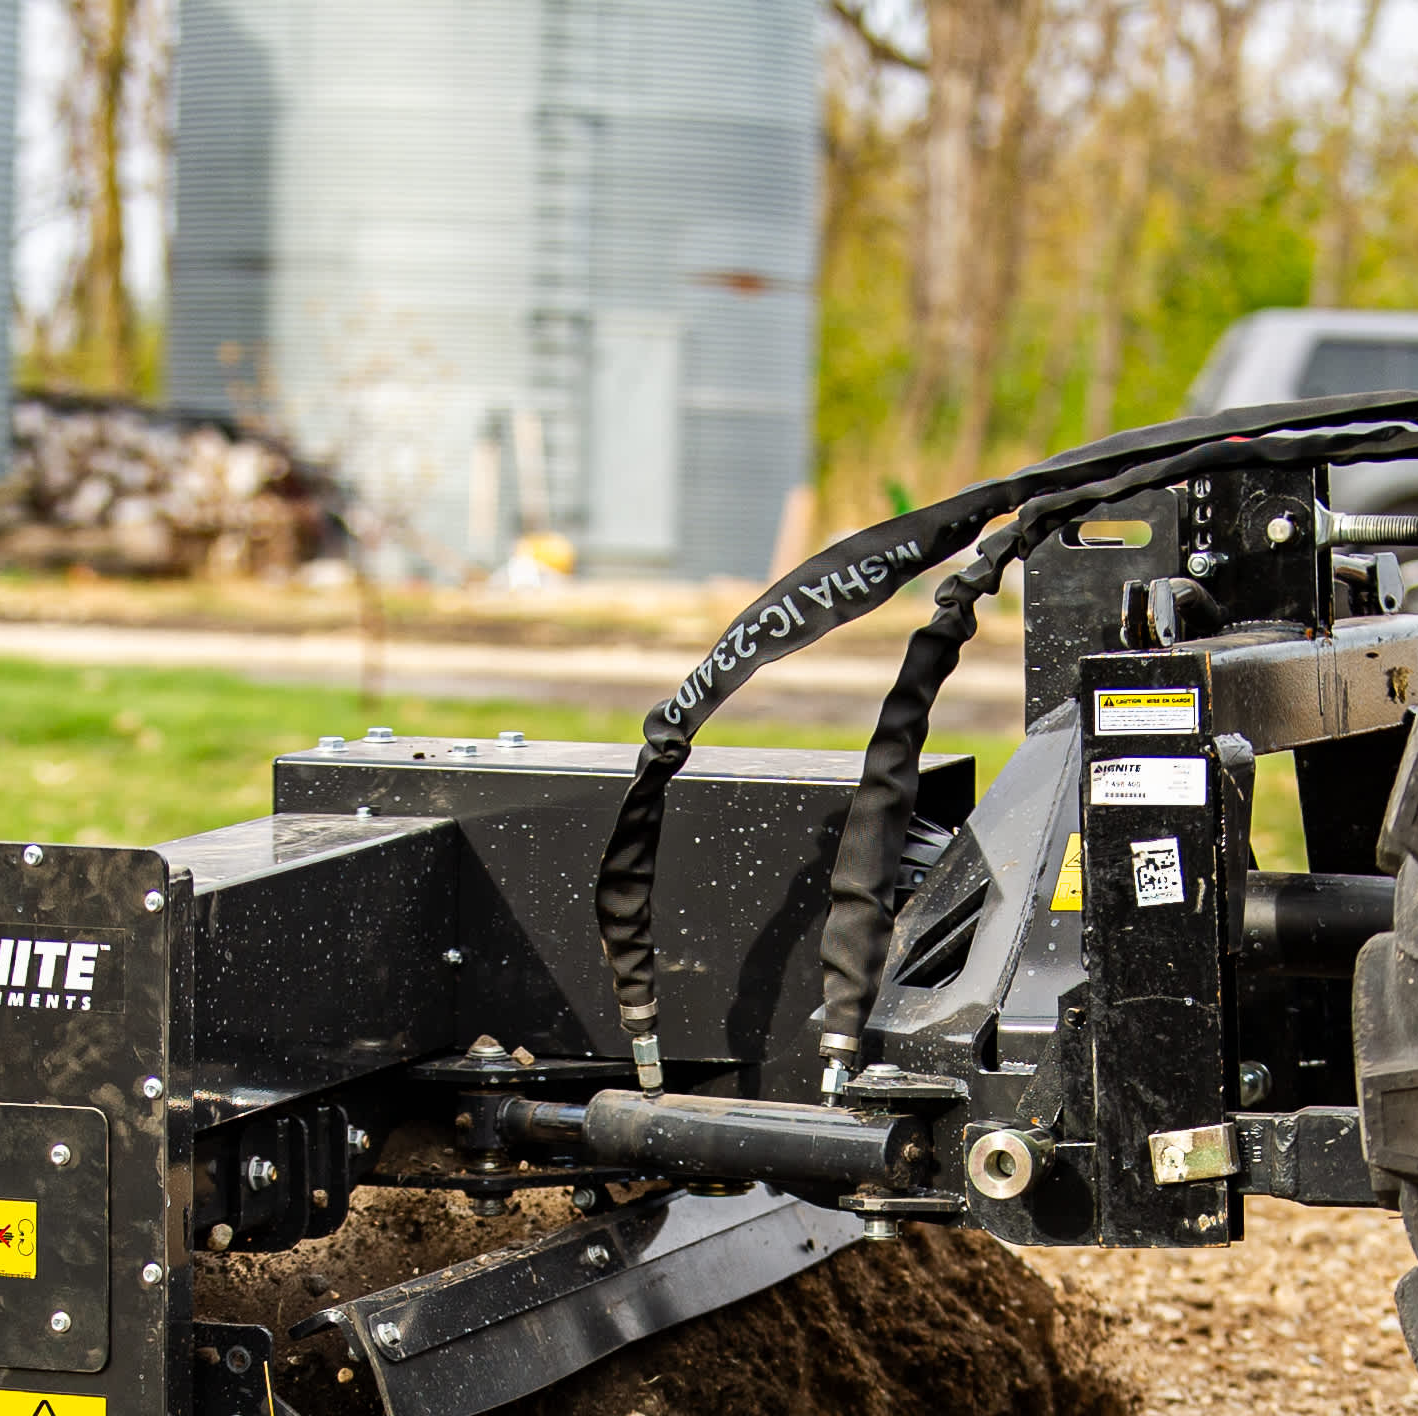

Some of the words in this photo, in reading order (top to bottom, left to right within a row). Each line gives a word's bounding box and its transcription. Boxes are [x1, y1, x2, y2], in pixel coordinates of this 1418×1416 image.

[798, 540, 923, 609] MSHA
[663, 594, 806, 725] IC-234/02
[1103, 764, 1142, 773] IGNITE
